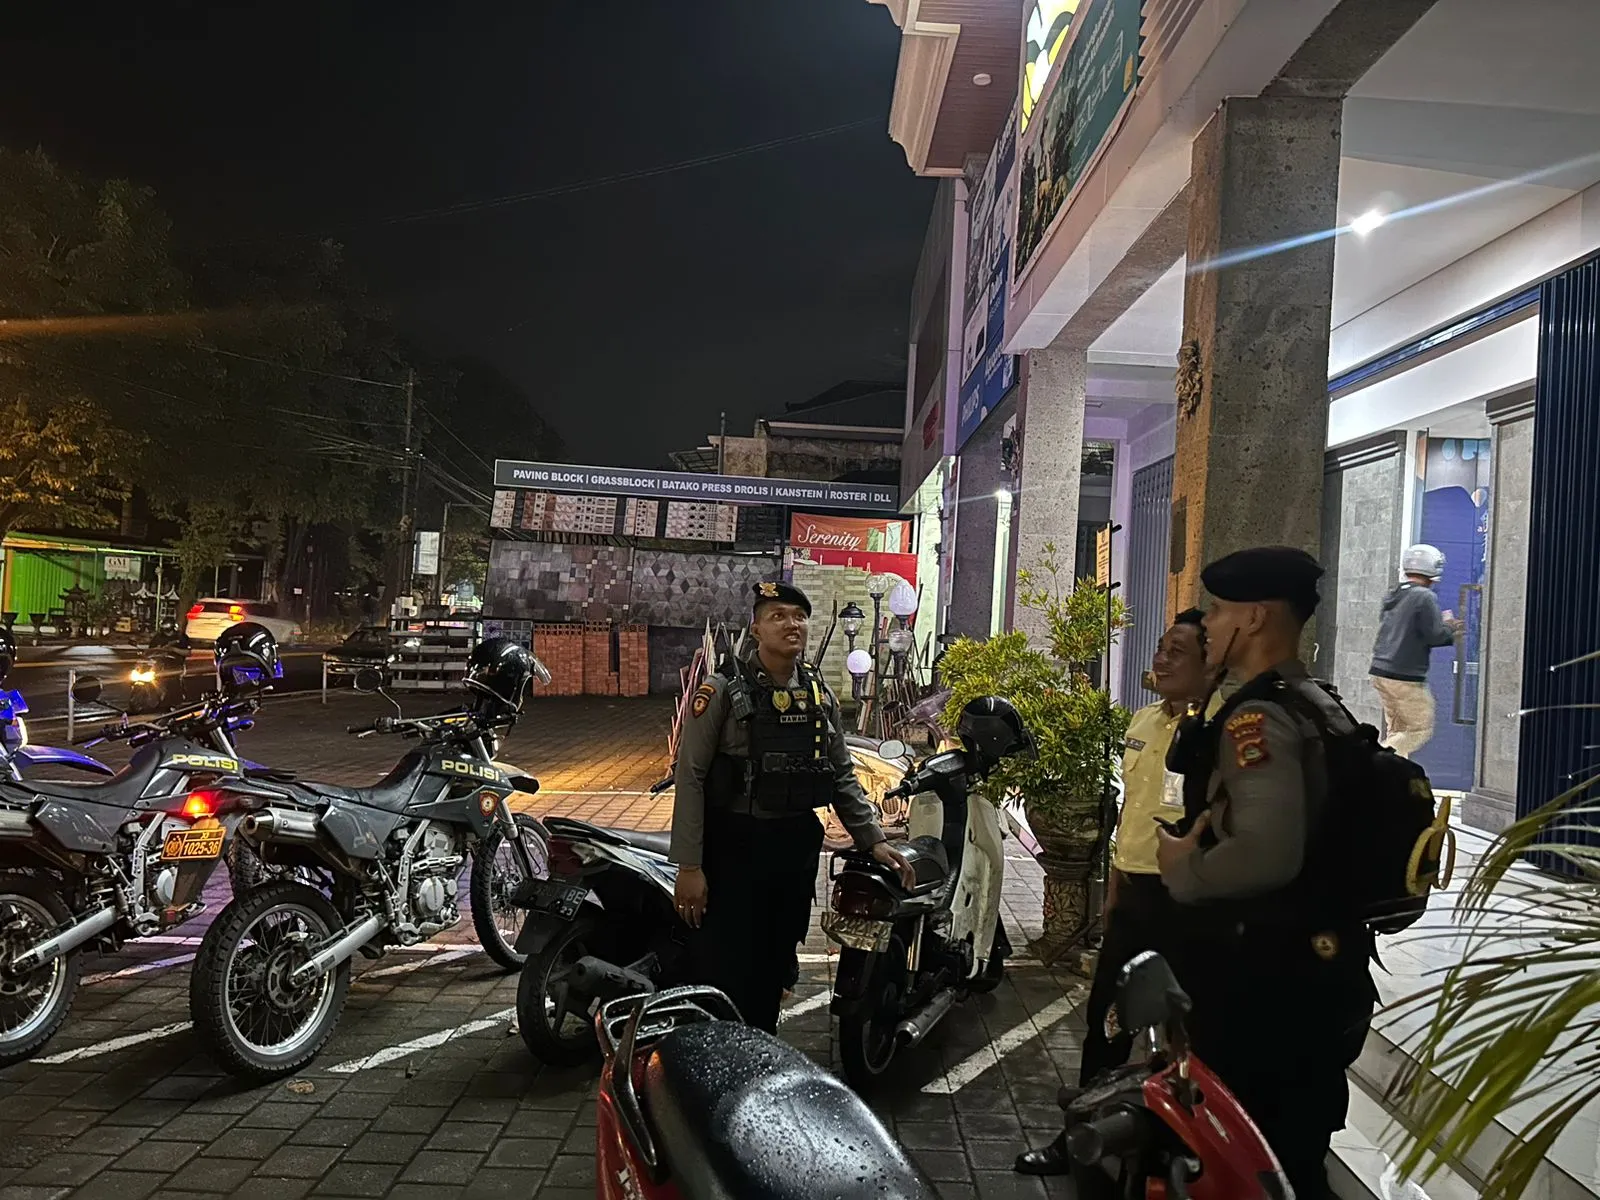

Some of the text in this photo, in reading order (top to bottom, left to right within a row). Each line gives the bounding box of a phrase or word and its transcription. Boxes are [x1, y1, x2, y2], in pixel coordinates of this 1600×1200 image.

[513, 469, 892, 502] PAVING BLOCK GRASSBLOCK BATAKO PRESS DROLIS KANSTEIN ROSTER DLL
[798, 524, 862, 551] Serenity
[173, 754, 239, 773] POLISI
[441, 760, 499, 781] POLISI
[183, 841, 219, 856] 1025-36
